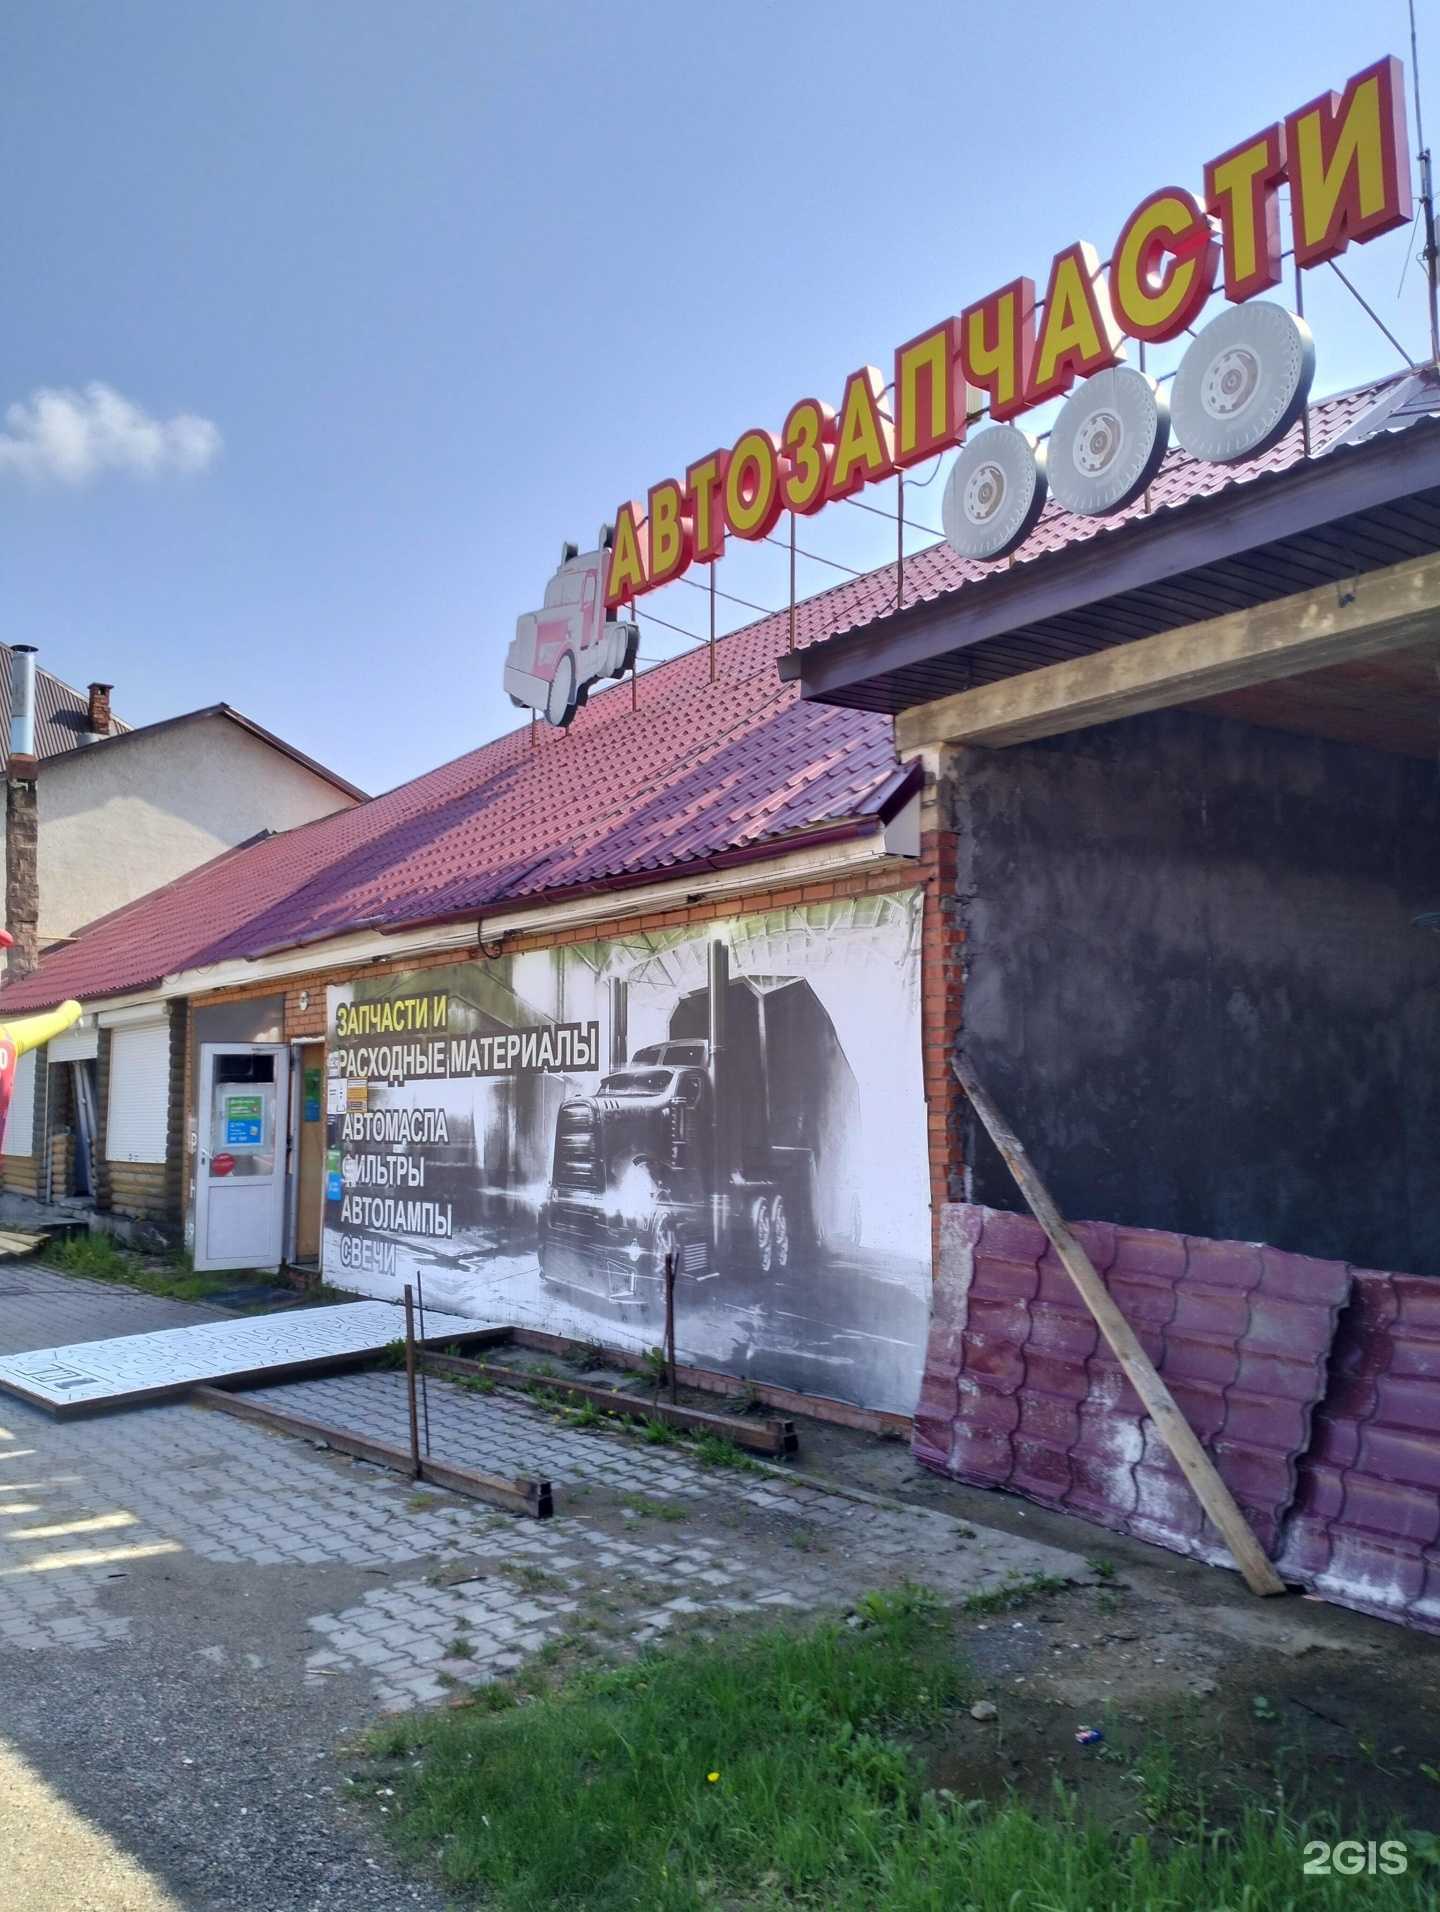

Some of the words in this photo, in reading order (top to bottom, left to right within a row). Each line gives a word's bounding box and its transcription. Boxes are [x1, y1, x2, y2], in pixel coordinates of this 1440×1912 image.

[605, 55, 1412, 607] АВТОЗАПЧАСТИ
[336, 997, 429, 1037] ЗАПЧАСТИ
[431, 995, 447, 1029] И
[338, 1041, 446, 1082] РАСХОДНЫЕ
[451, 1027, 597, 1074] МАТЕРИАЛЫ
[341, 1110, 449, 1143] АВТОМАСЛА
[340, 1197, 452, 1238] АВТОЛАМПЫ
[340, 1235, 397, 1276] СВЕЧИ
